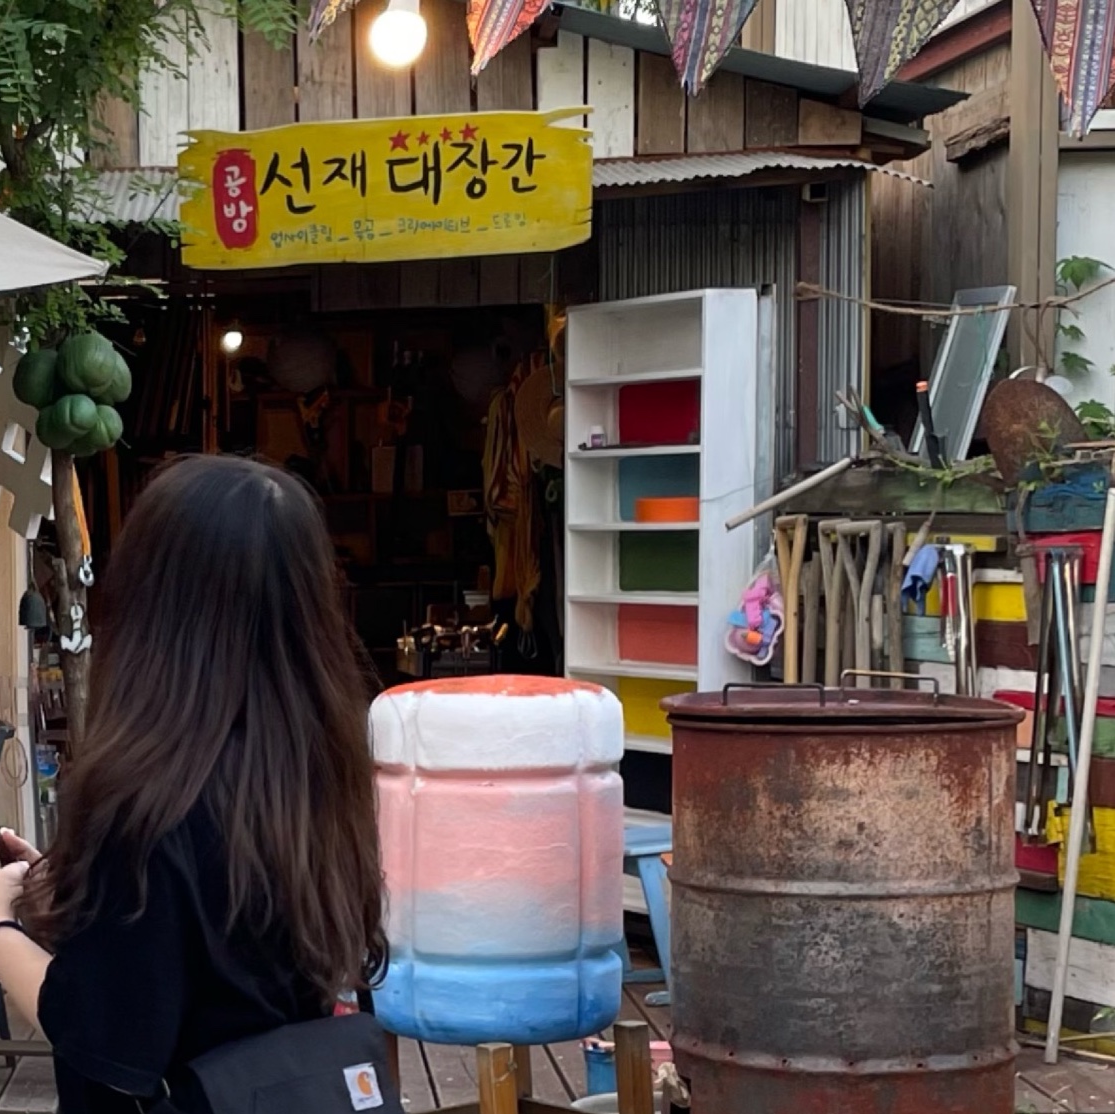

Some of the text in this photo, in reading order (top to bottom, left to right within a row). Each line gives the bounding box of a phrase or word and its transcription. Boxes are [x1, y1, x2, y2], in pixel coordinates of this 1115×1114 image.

[223, 165, 253, 233] 공방
[259, 138, 546, 214] 선재 대장간
[270, 223, 333, 248] 업사이클링
[353, 219, 374, 241] 목공
